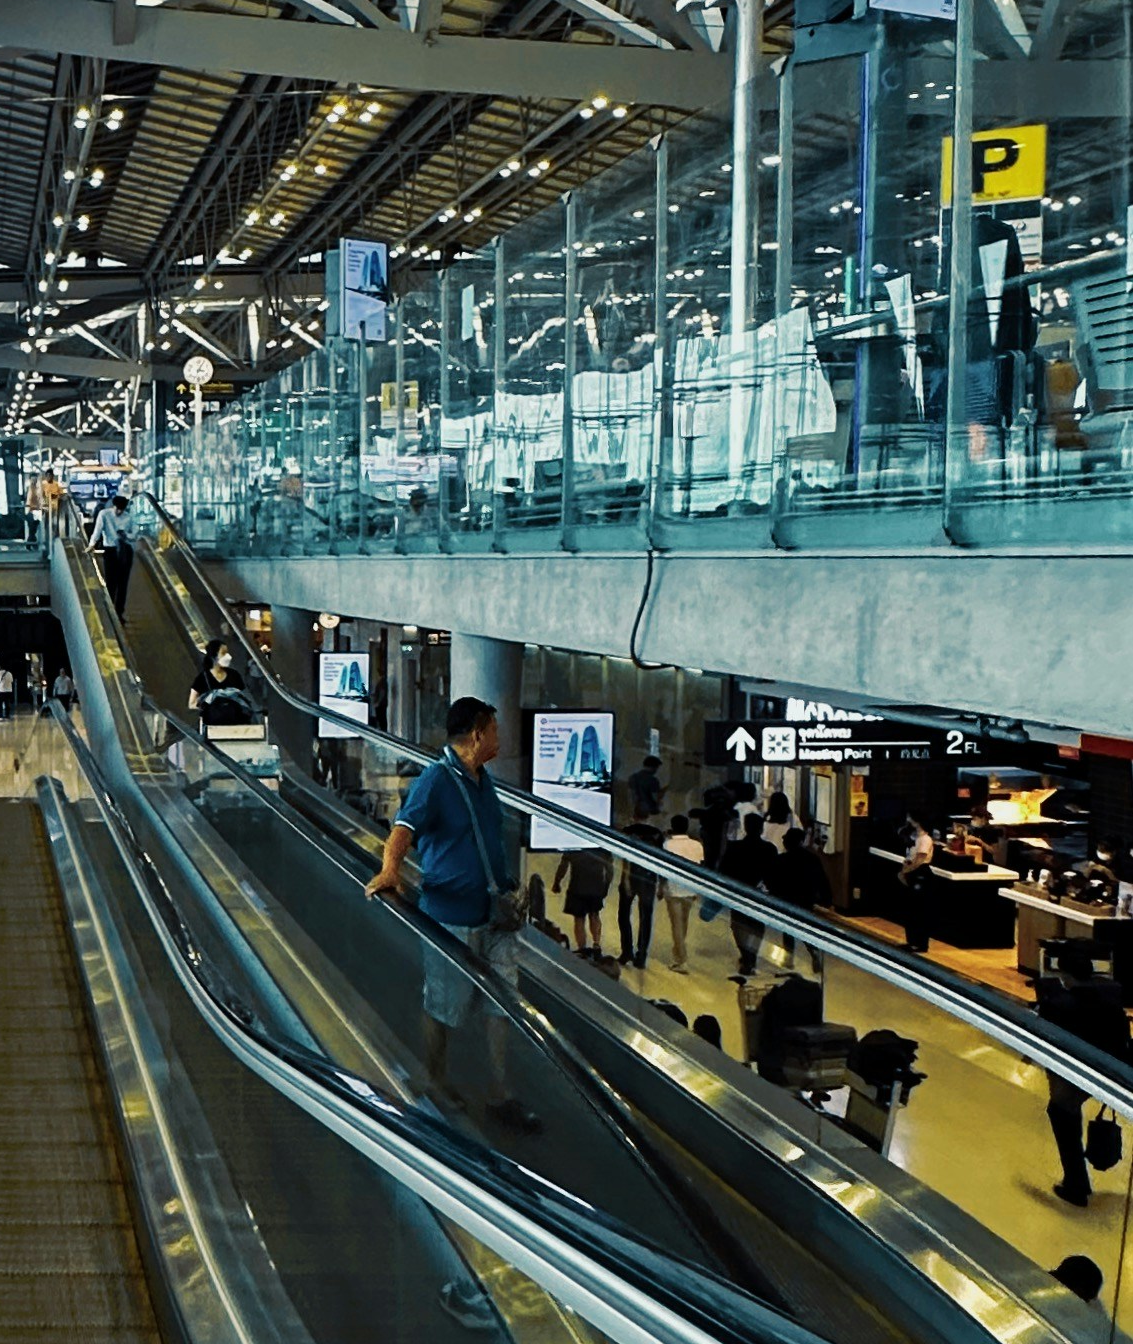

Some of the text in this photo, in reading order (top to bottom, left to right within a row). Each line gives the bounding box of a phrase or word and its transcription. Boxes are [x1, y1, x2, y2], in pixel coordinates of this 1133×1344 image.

[971, 138, 1020, 194] P
[798, 747, 872, 762] Meeting Point
[946, 730, 982, 755] 2 FL
